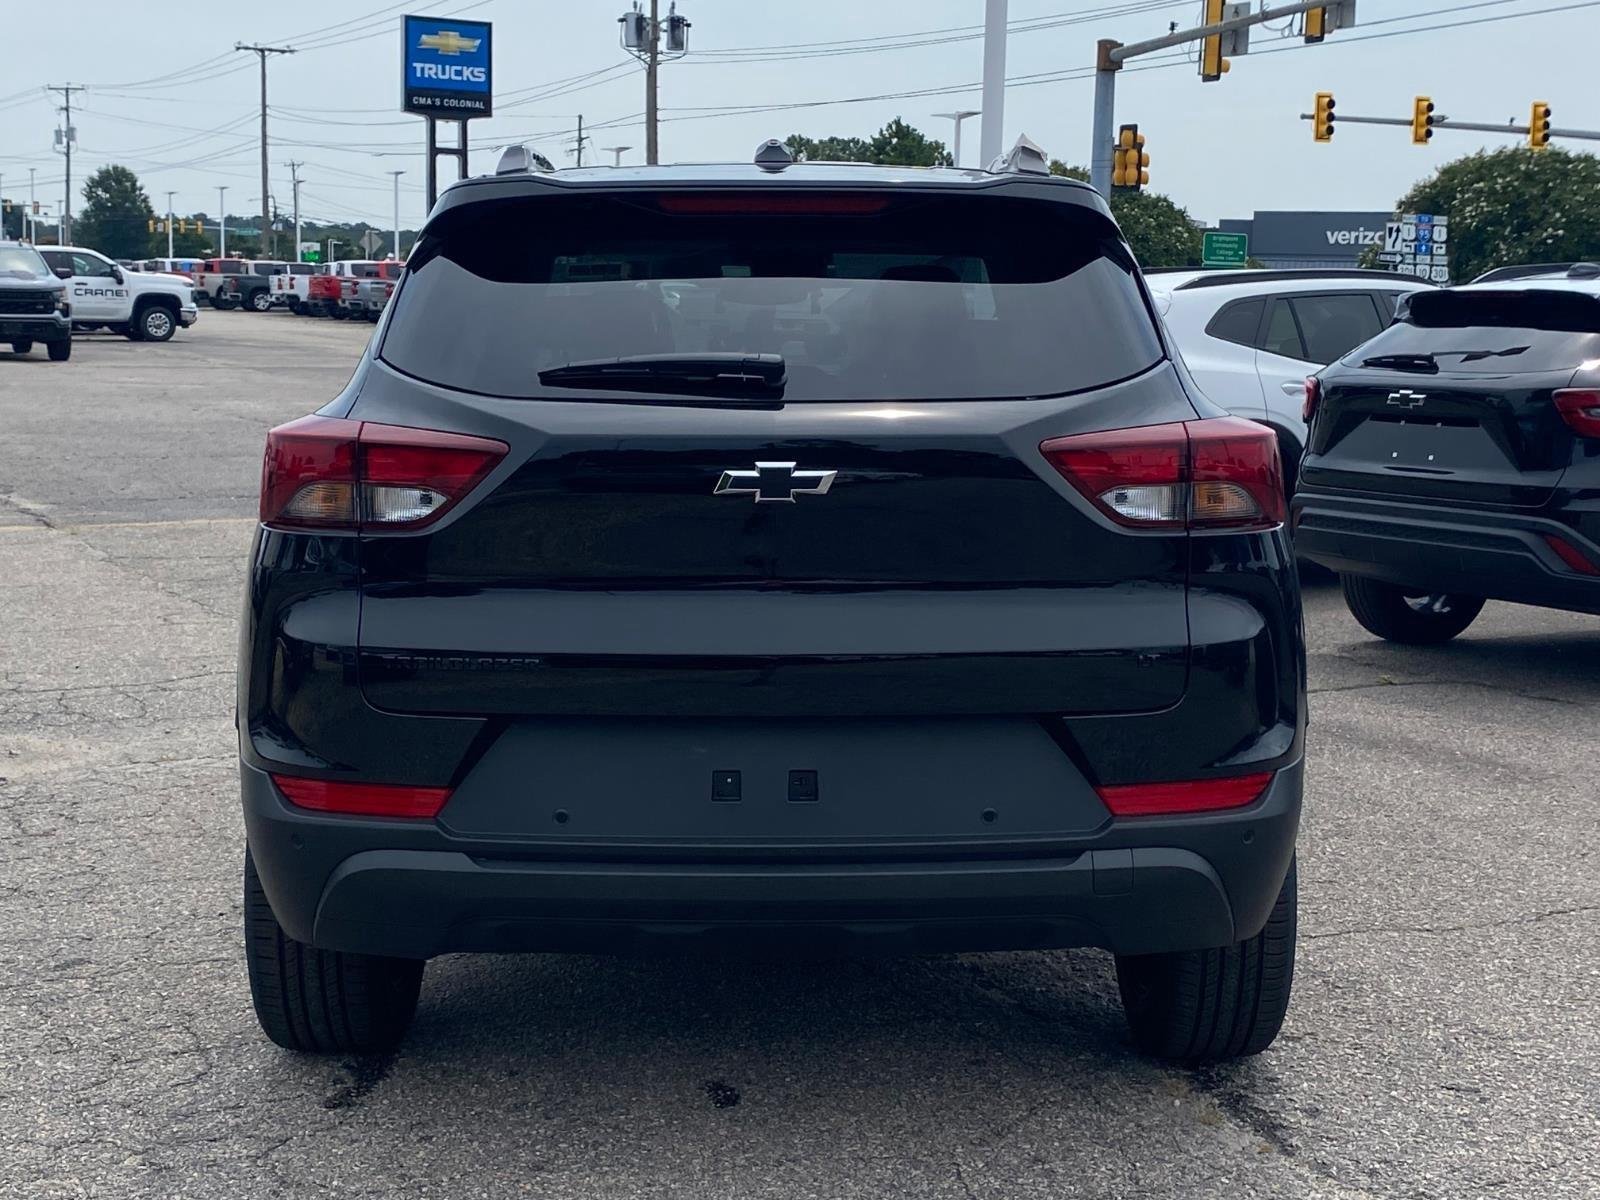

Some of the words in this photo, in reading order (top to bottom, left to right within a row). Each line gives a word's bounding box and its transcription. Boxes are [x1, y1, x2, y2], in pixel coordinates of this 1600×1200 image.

[412, 62, 486, 82] TRUCKS
[412, 96, 441, 106] CMA'S
[443, 98, 485, 109] COLONIAL
[1325, 227, 1385, 245] verizo
[1419, 229, 1430, 239] 95
[1433, 269, 1447, 279] 301
